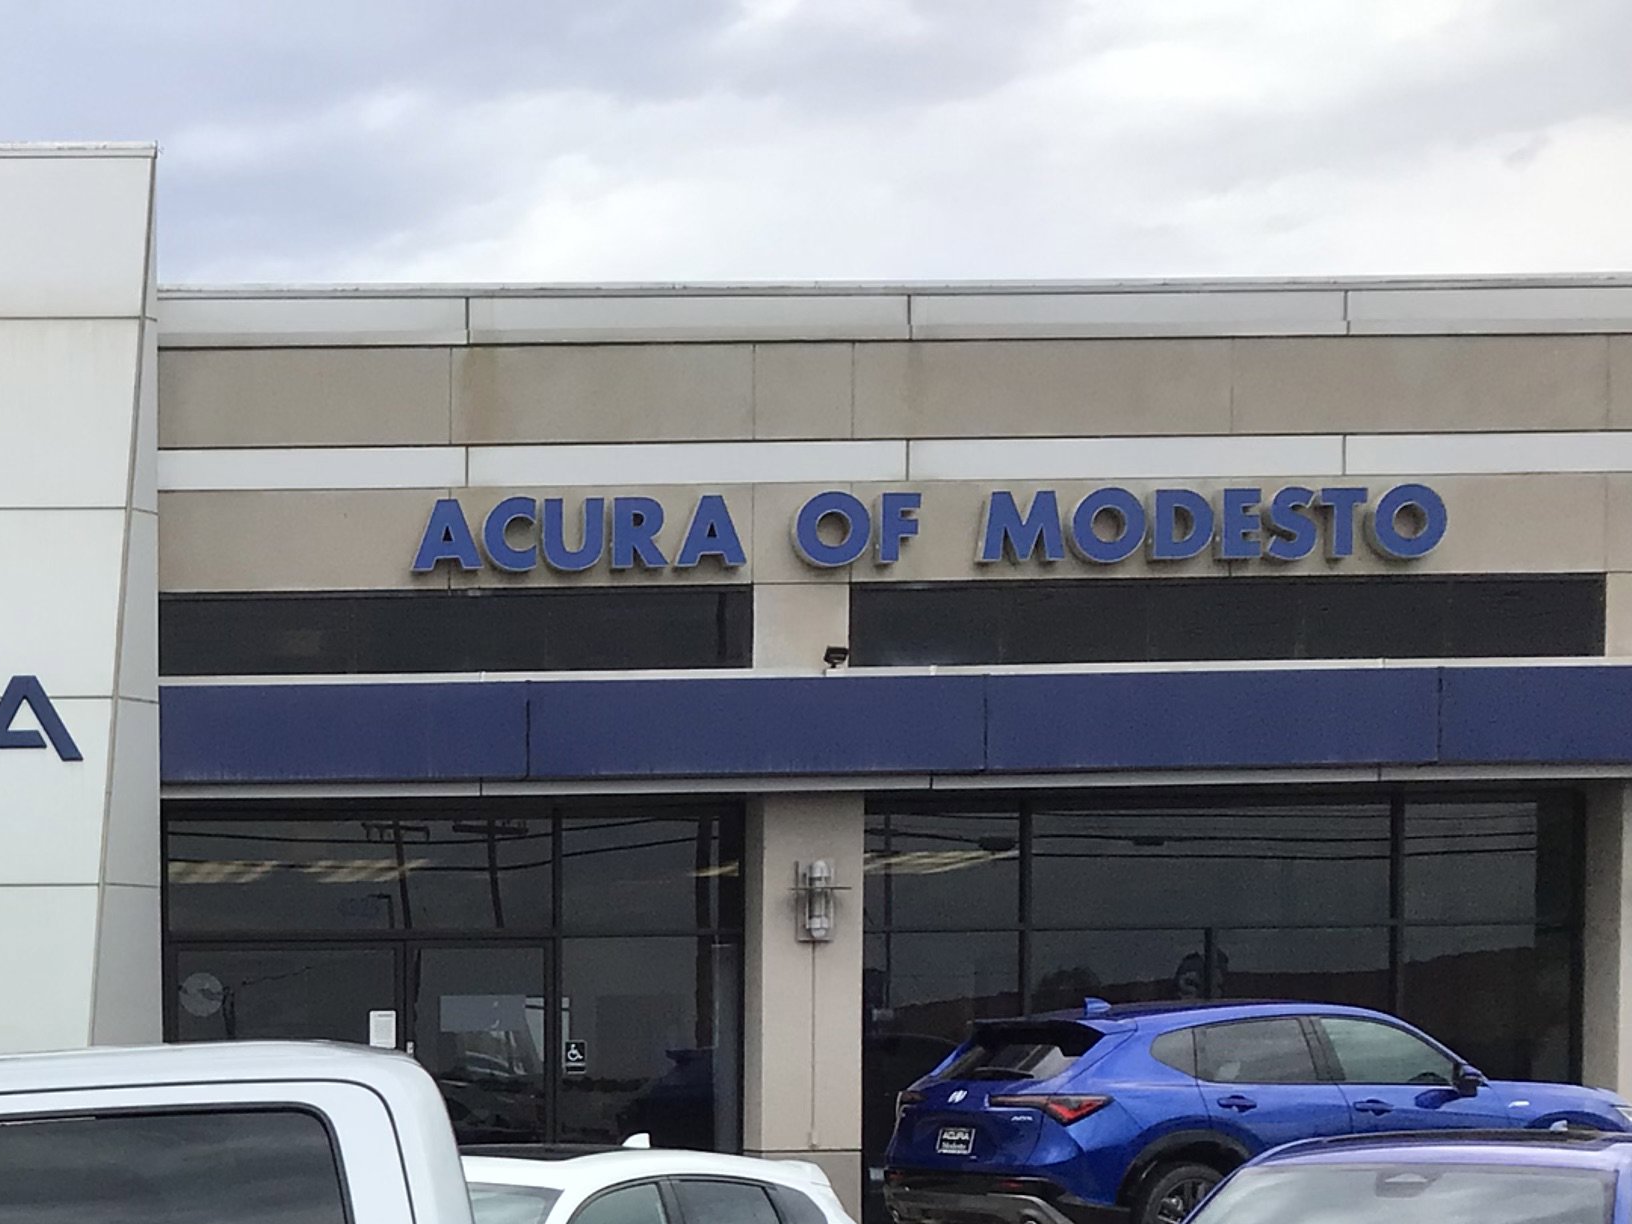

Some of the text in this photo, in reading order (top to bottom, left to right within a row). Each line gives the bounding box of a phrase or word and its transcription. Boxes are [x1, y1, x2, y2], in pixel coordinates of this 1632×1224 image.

[410, 483, 1449, 572] ACURA OF MODESTO
[942, 1131, 970, 1140] ACURA
